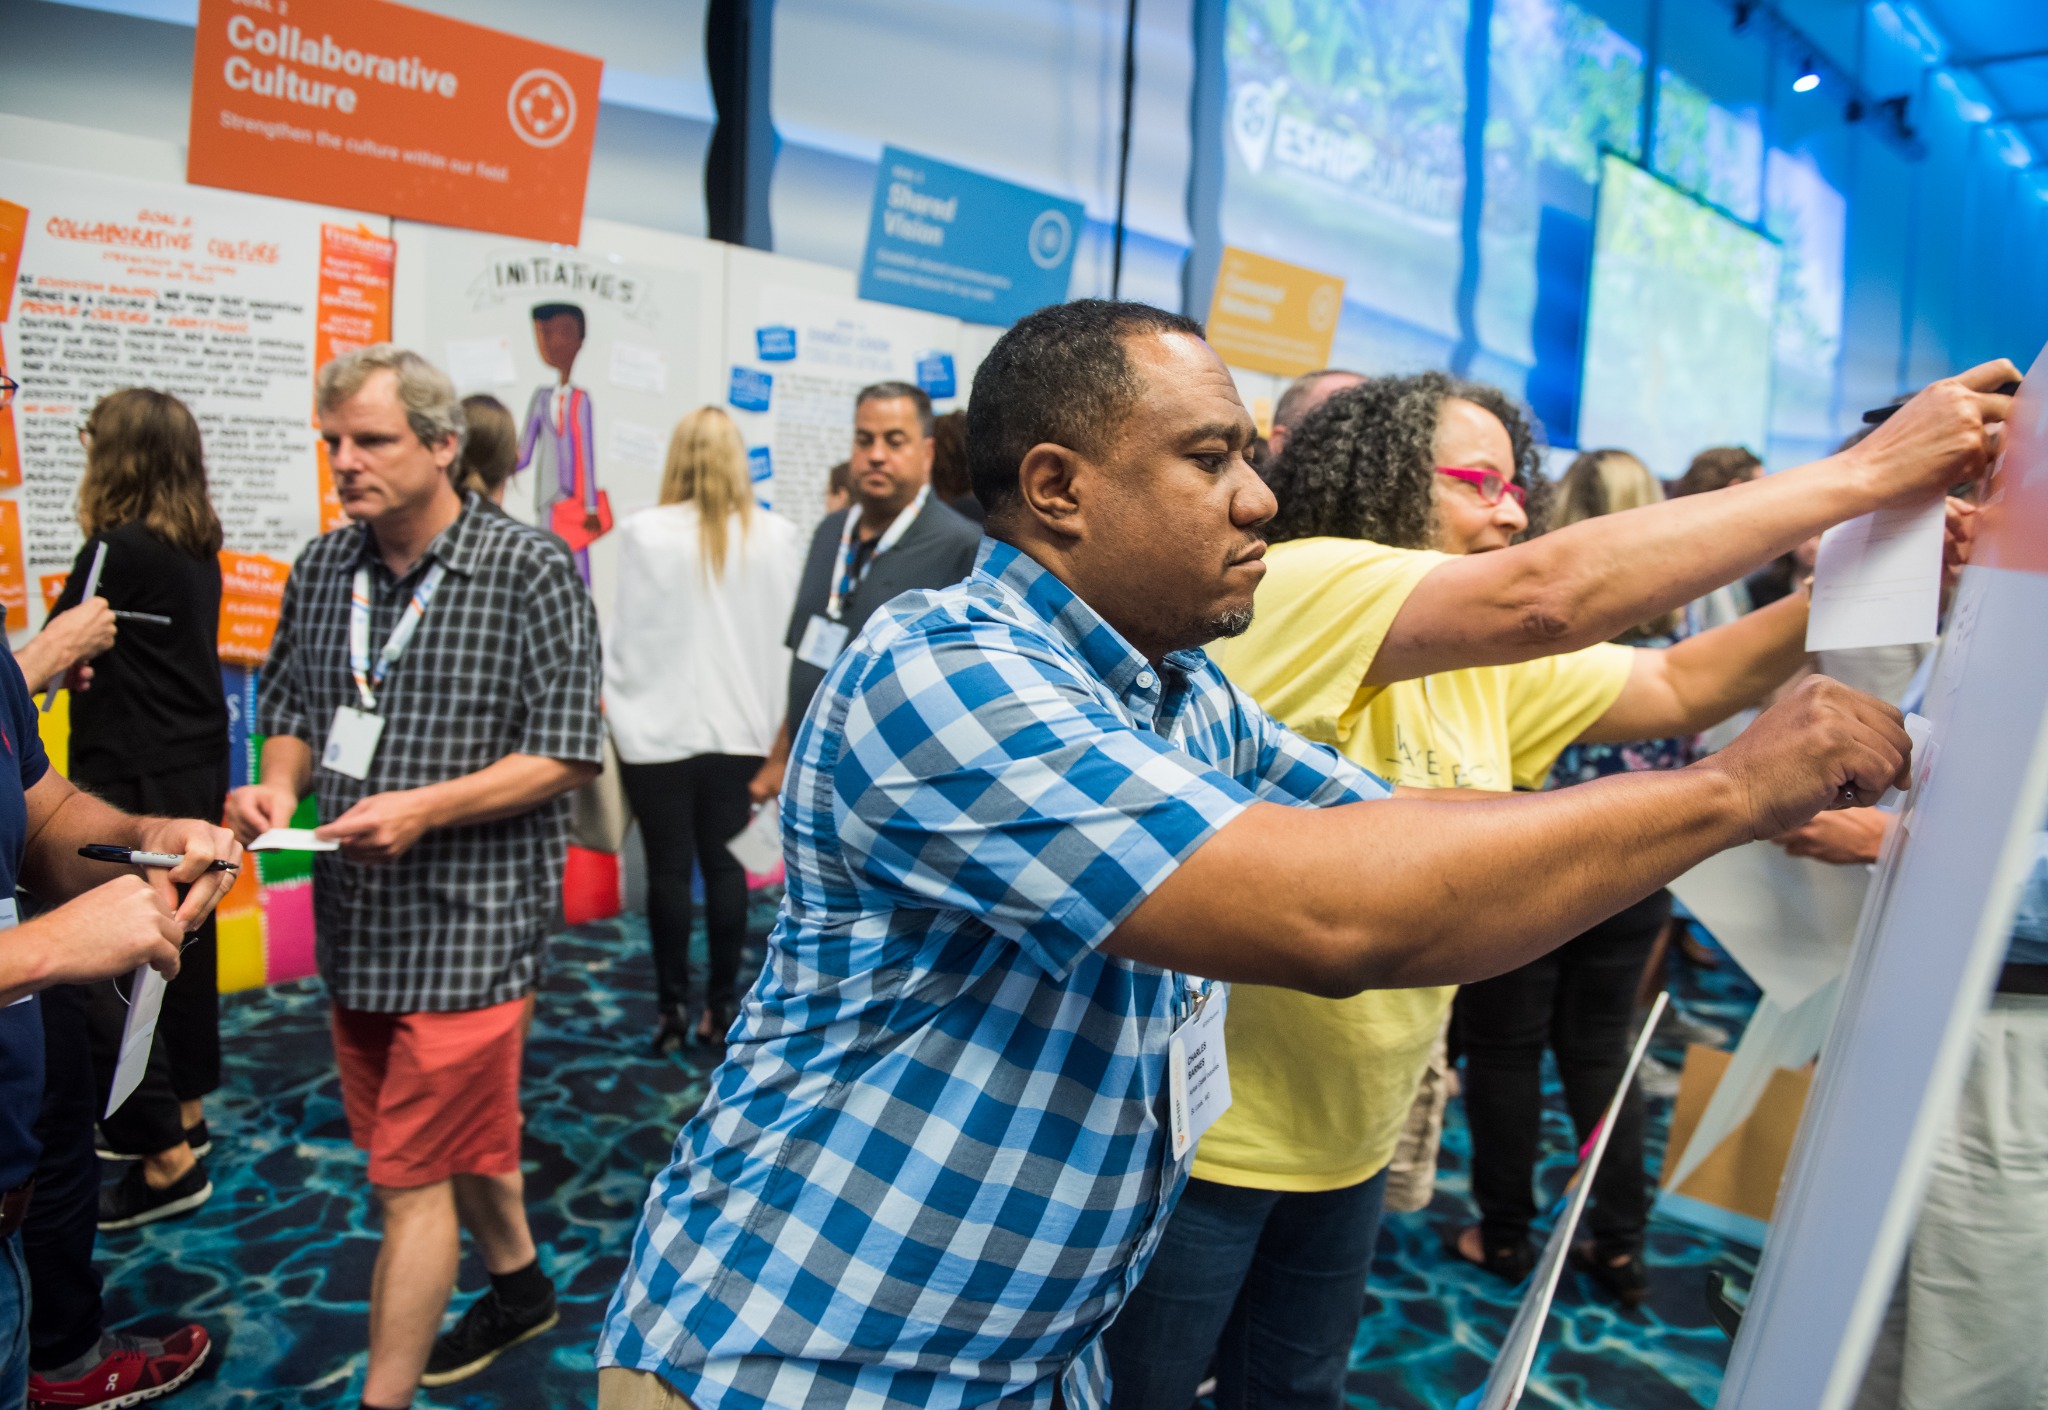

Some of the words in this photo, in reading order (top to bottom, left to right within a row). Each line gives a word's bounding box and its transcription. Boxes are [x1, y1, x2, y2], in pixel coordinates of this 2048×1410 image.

[227, 14, 458, 98] Collaborative
[224, 55, 357, 114] Culture
[219, 109, 313, 144] Strengthen
[315, 129, 343, 151] the
[345, 138, 399, 161] culture
[402, 150, 447, 170] within
[450, 158, 473, 176] our
[45, 215, 193, 251] COLLABORATIVE
[207, 236, 280, 265] CULTURE
[495, 257, 635, 304] INITIATIVES
[1187, 1041, 1207, 1066] CHARLES
[1188, 1057, 1206, 1081] BARNES
